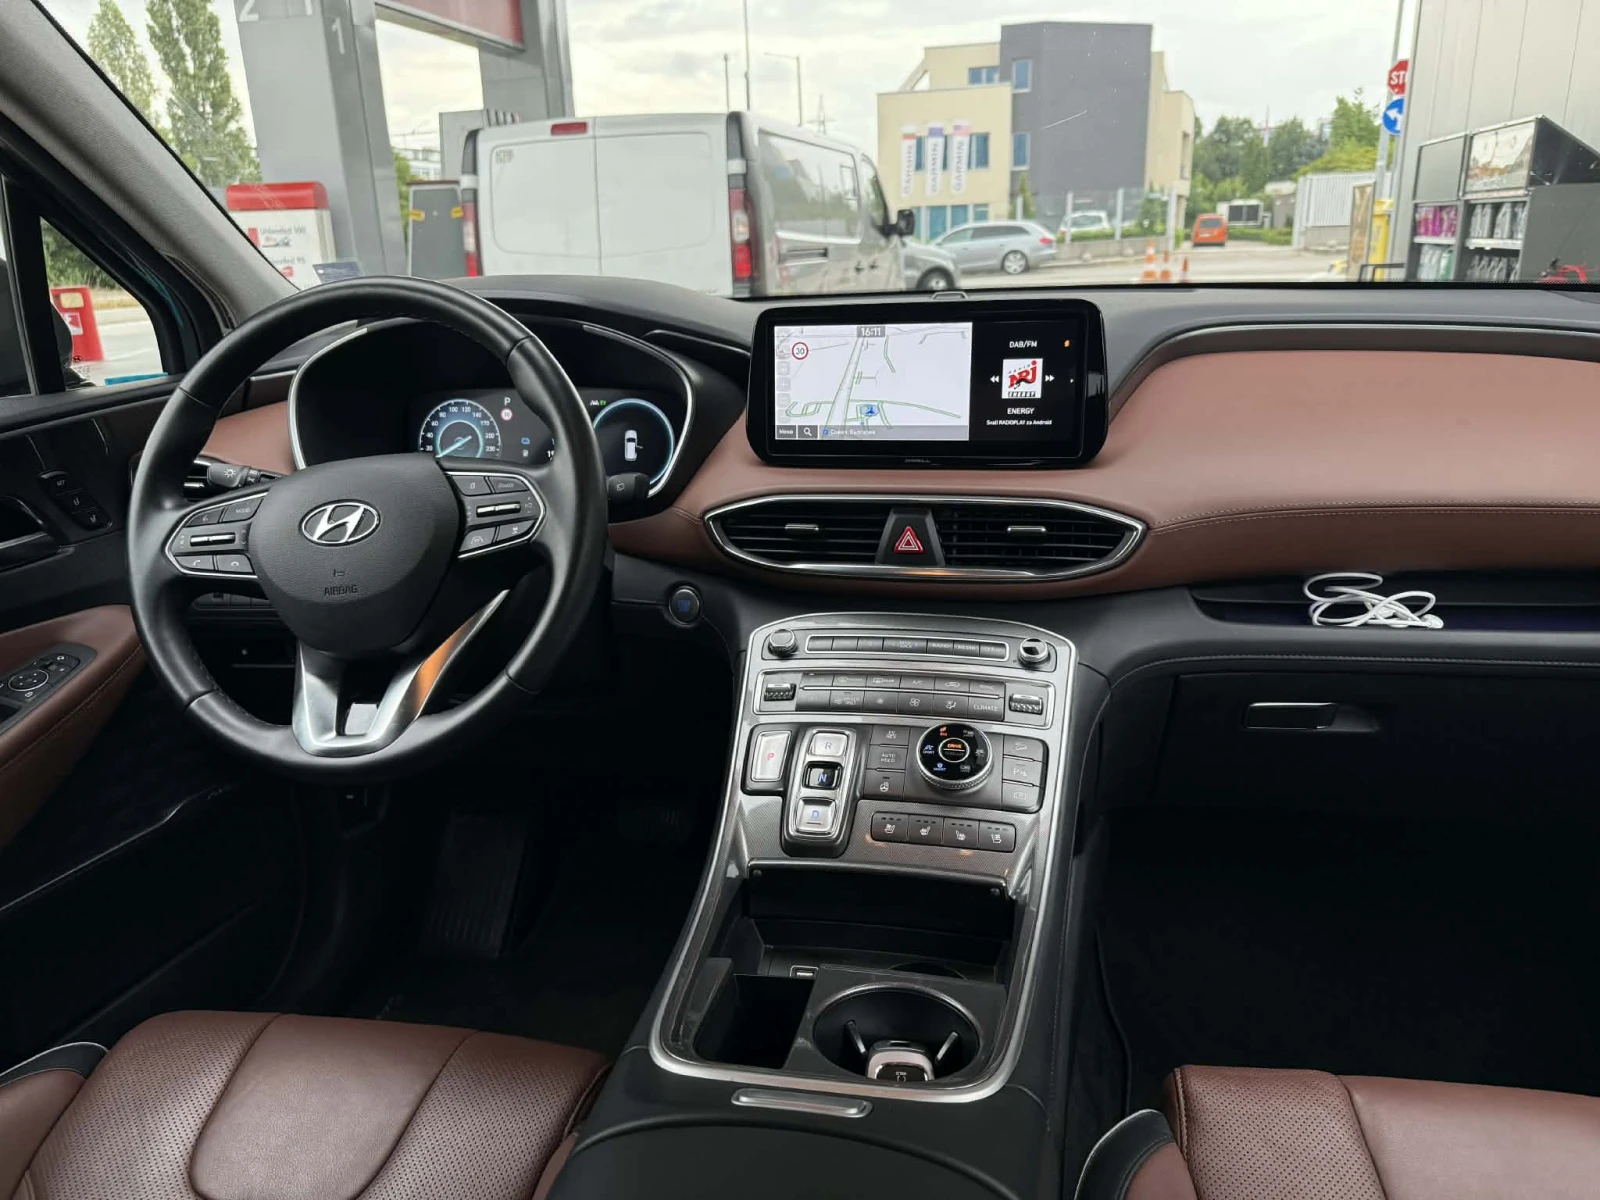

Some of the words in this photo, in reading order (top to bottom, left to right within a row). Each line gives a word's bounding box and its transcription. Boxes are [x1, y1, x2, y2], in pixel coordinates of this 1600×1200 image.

[1390, 70, 1408, 85] ST
[860, 327, 882, 337] 16:11
[1009, 340, 1038, 349] DAB/FM
[795, 347, 805, 355] 30
[504, 397, 511, 406] P
[1006, 407, 1035, 415] ENERGY
[324, 584, 358, 596] AIRBAG
[973, 704, 999, 712] CLIMATE
[824, 742, 832, 750] R
[767, 752, 775, 760] P
[818, 774, 827, 782] N
[811, 809, 820, 819] D
